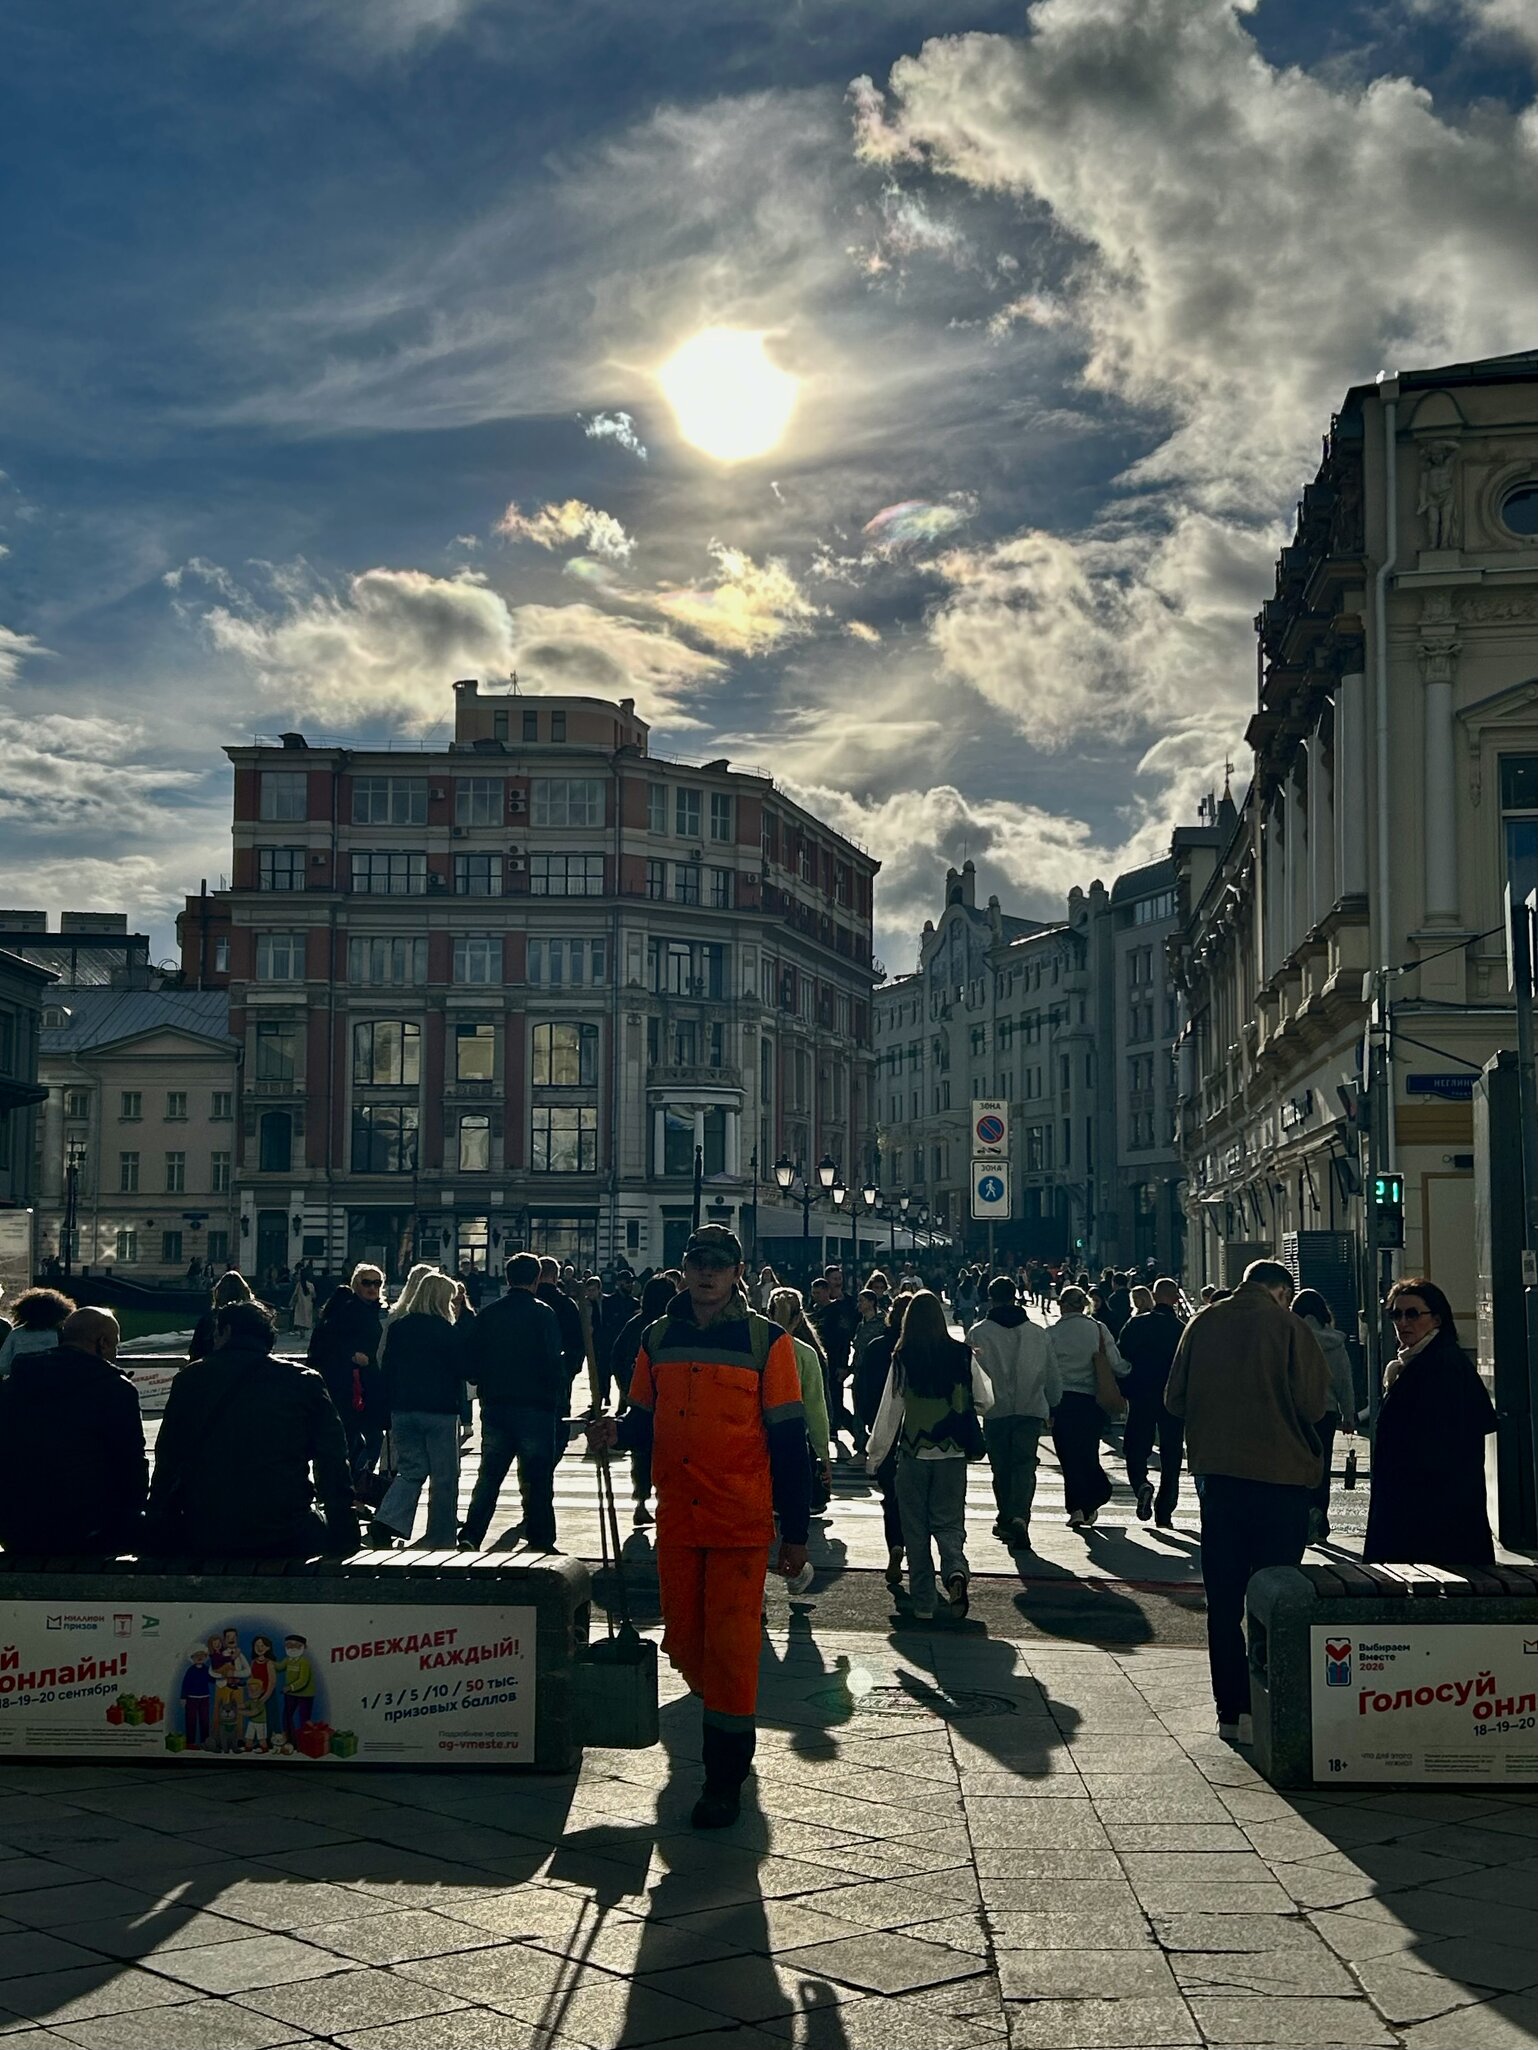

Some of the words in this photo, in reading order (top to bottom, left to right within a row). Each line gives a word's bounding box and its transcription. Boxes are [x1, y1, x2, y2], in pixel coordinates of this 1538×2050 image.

[979, 1102, 1001, 1110] ЗОНА
[981, 1164, 1002, 1172] ЗОНА
[330, 1628, 458, 1663] ПОБЕЖДАЕТ
[419, 1636, 520, 1670] КАЖДЫЙ!
[1359, 1643, 1411, 1652] Выбираем
[1359, 1653, 1396, 1662] Вместе
[0, 1652, 128, 1693] онлайн!
[1359, 1662, 1385, 1671] 2026
[58, 1683, 118, 1700] сентября
[361, 1696, 368, 1709] 1
[384, 1693, 393, 1706] 3
[410, 1688, 419, 1701] 5
[466, 1678, 484, 1693] 50
[487, 1674, 519, 1689] тыс.
[1358, 1670, 1496, 1715] Голосуй
[384, 1699, 458, 1723] призовых
[461, 1690, 517, 1709] баллов
[1472, 1693, 1537, 1720] онл
[438, 1739, 519, 1751] ag-vmeste.ru
[1328, 1758, 1349, 1772] 18+
